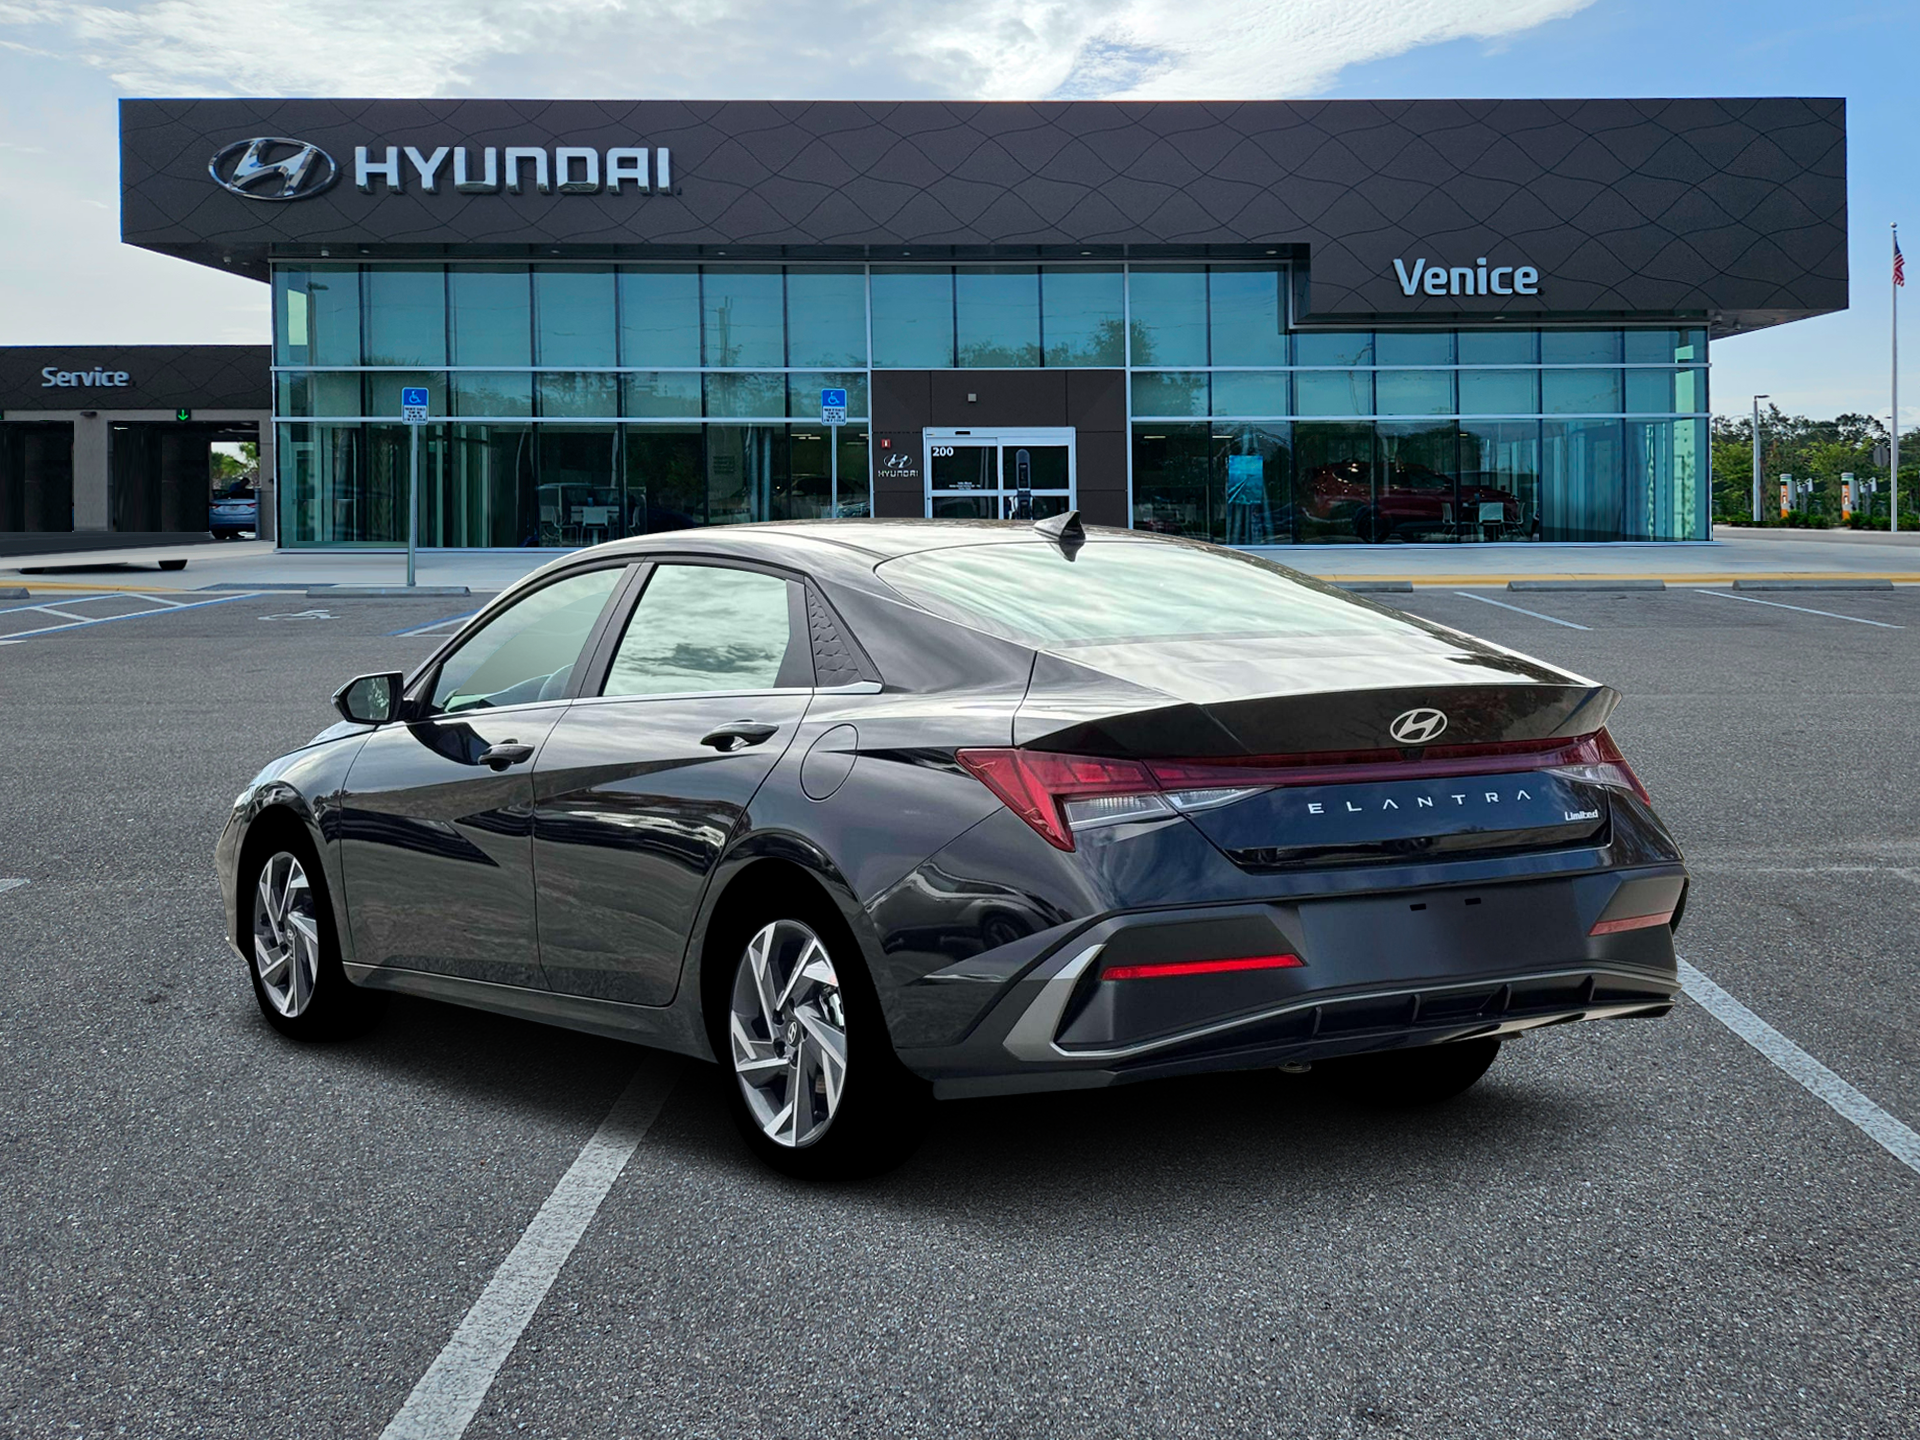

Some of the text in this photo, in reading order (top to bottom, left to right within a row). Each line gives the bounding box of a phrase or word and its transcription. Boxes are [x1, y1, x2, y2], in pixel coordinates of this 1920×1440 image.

[354, 146, 671, 194] HYUNDAI
[1393, 257, 1539, 296] Venice
[41, 366, 130, 387] Service
[932, 446, 954, 457] 200
[877, 469, 919, 477] HYUNDAI
[1308, 790, 1532, 815] ELANTRA
[1564, 809, 1599, 822] Limited
